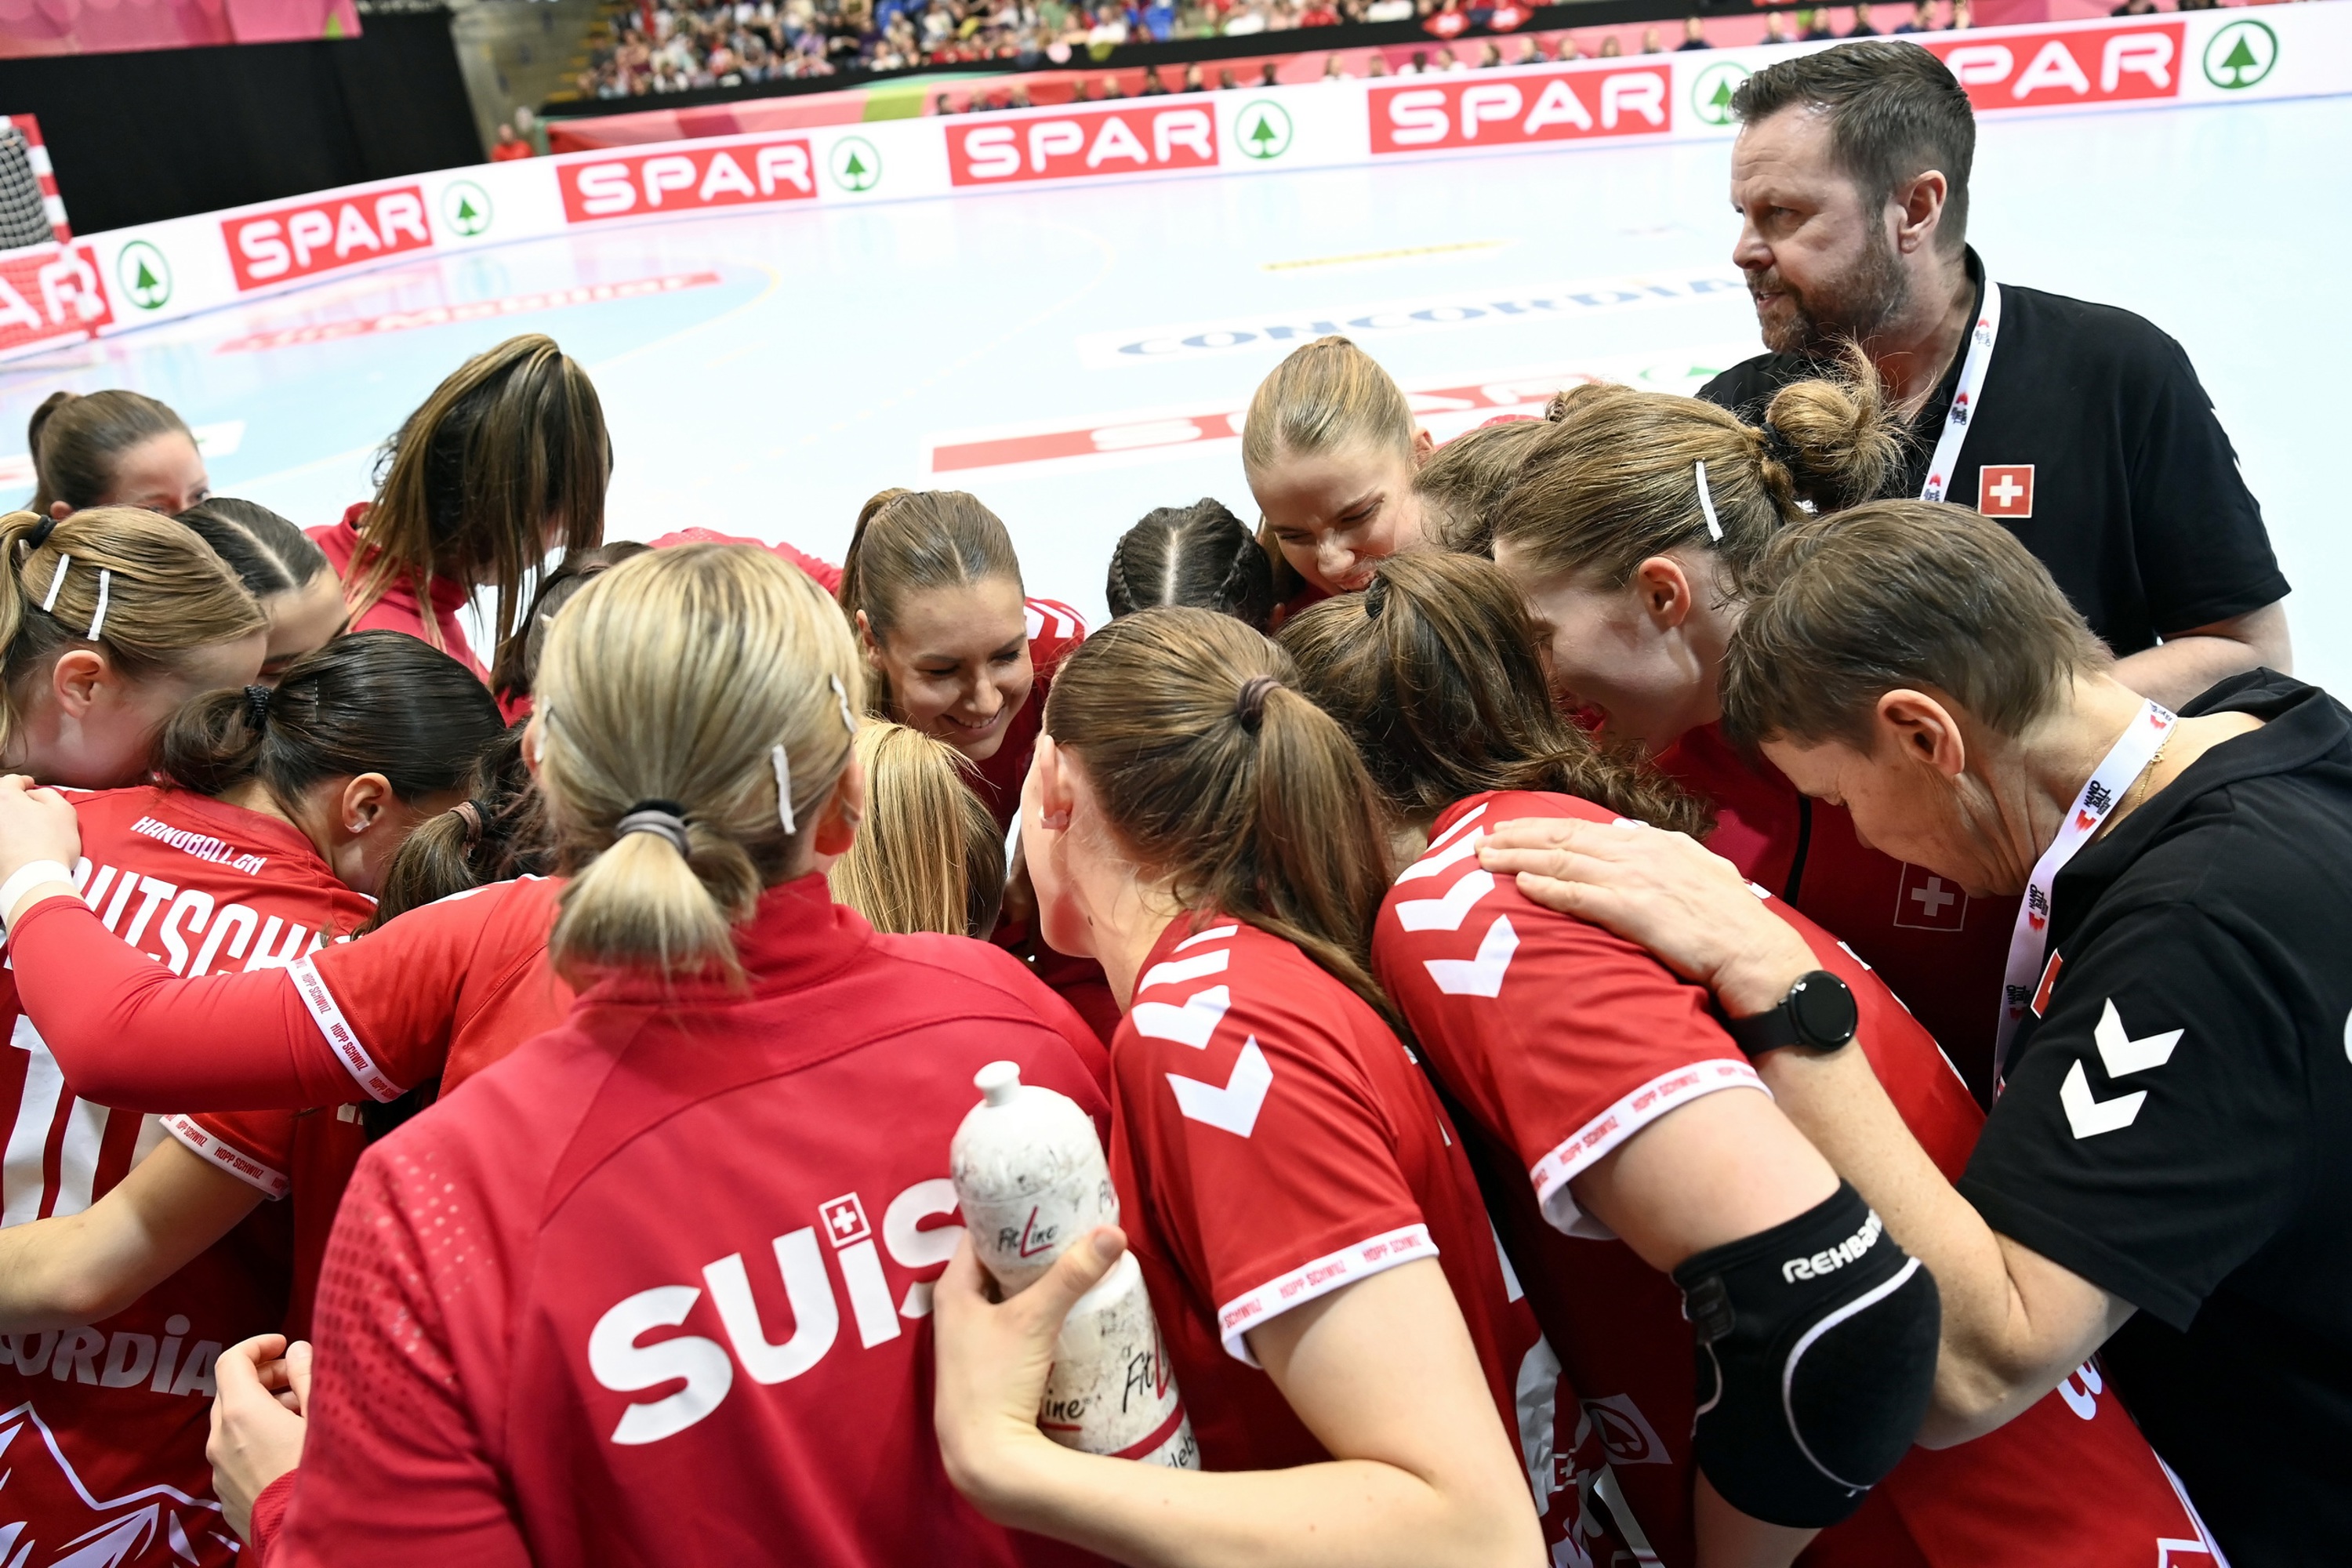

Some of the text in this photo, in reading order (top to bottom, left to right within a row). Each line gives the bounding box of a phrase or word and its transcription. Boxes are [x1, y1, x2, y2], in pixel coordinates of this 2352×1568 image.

[1388, 72, 1665, 145] SPAR
[964, 108, 1213, 178] SPAR
[577, 147, 812, 216] SPAR
[238, 191, 426, 279] SPAR
[2084, 779, 2101, 808] HAND
[2092, 787, 2111, 808] BALL
[129, 815, 268, 877] HANDBALL.CH
[2029, 884, 2038, 909] HAND
[301, 972, 316, 987] HOPP
[330, 1022, 349, 1043] HOPP
[213, 1146, 236, 1163] HOPP
